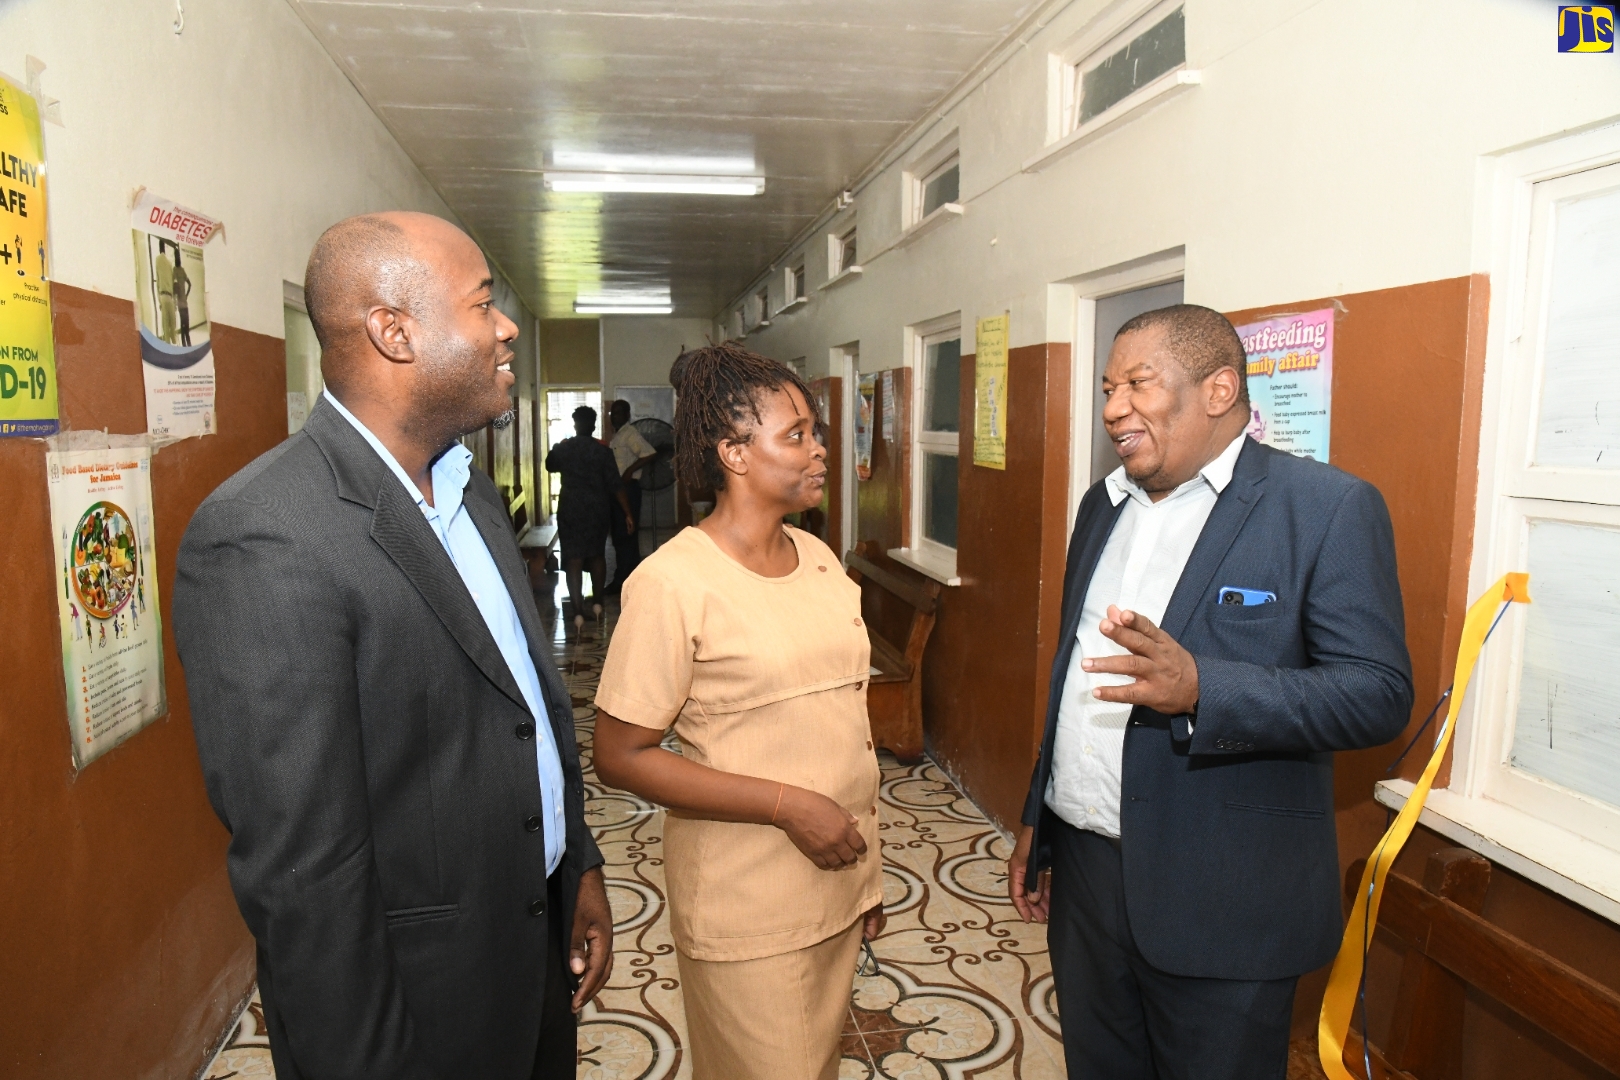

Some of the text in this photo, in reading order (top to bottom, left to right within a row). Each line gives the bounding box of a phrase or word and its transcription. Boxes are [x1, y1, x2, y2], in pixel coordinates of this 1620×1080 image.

[0, 151, 38, 188] LTHY
[149, 206, 213, 240] DIABETES
[176, 233, 205, 248] are forever
[13, 292, 32, 302] physical
[1243, 320, 1327, 353] astfeeding
[0, 345, 39, 362] N FROM
[1246, 350, 1320, 376] mily affair
[62, 465, 77, 476] Food
[78, 463, 95, 474] Based
[95, 463, 115, 472] Dietary
[90, 472, 122, 484] for Jamaica
